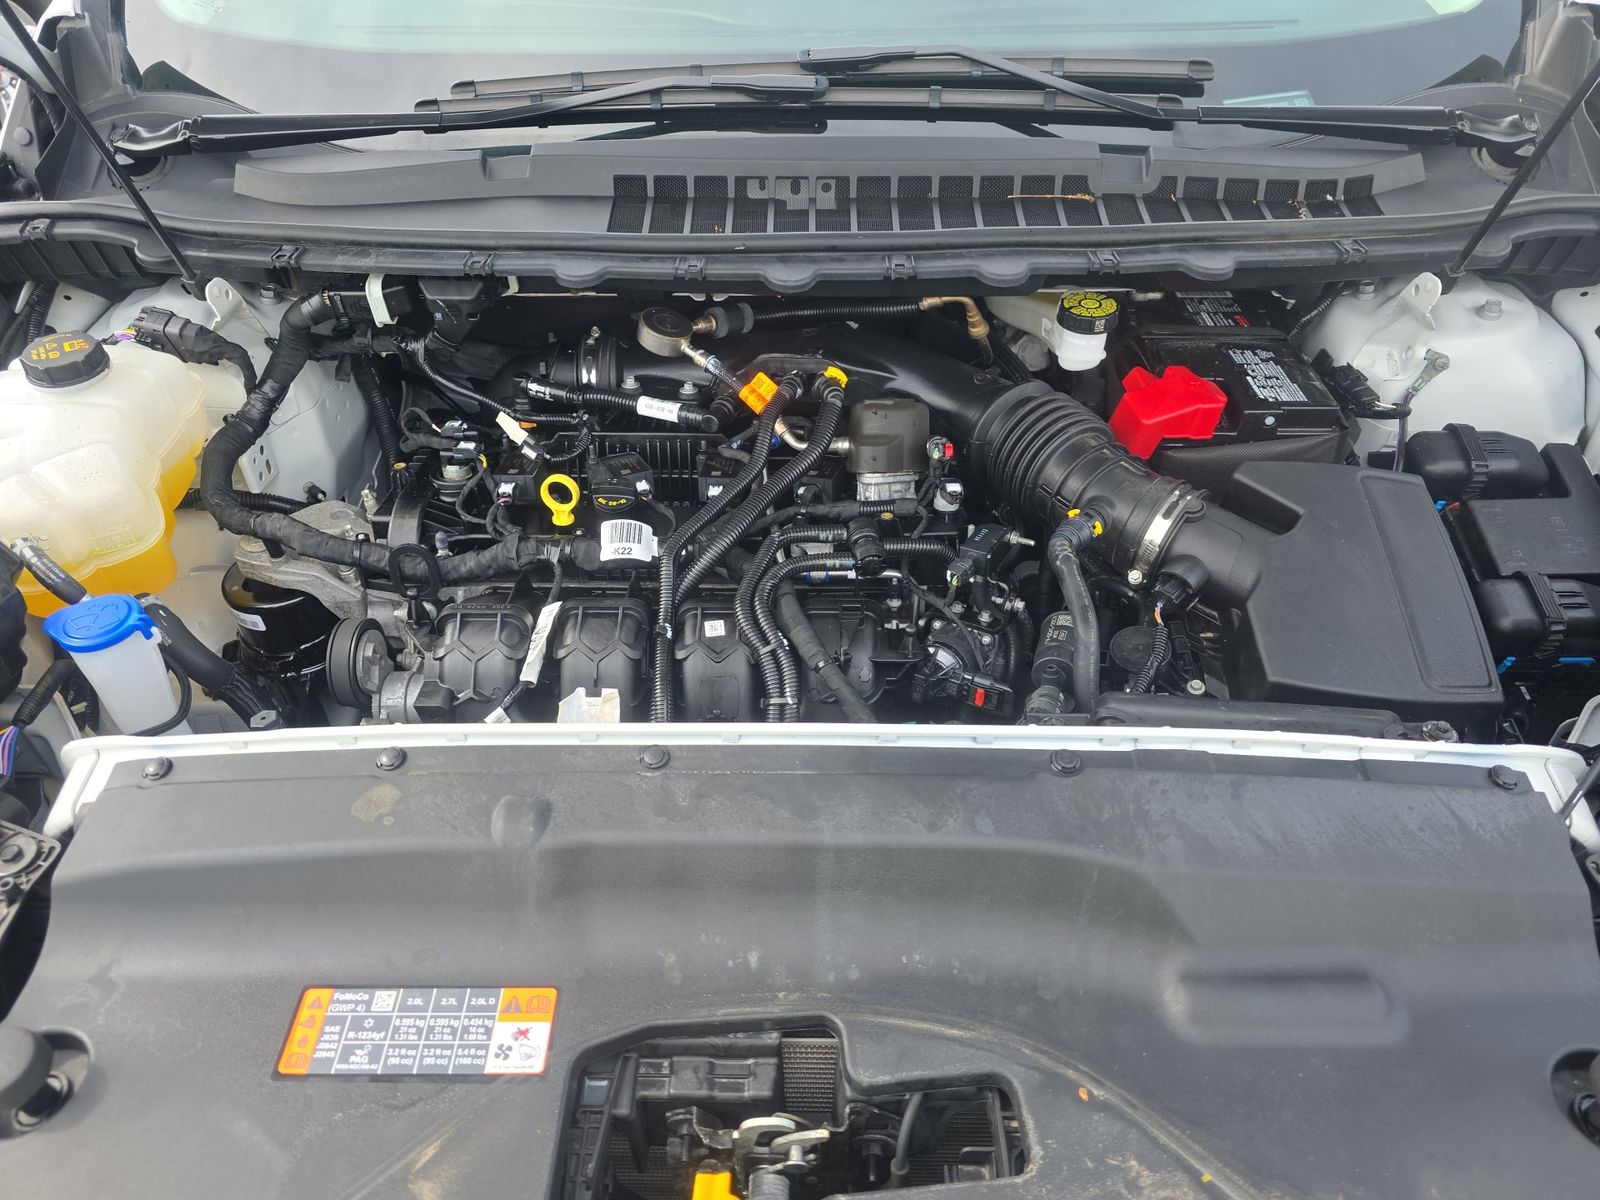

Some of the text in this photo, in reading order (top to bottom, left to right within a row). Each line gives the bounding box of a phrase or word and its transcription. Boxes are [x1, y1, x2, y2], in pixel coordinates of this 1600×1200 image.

[333, 992, 369, 1001] FoMoCo
[406, 997, 424, 1006] 2.0L
[440, 997, 458, 1006] 2.7L
[470, 997, 496, 1006] 2.0L D
[327, 1003, 366, 1013] (GWP 4)
[415, 1018, 425, 1029] kg
[450, 1018, 460, 1029] kg
[463, 1018, 494, 1028] 0.454 kg
[323, 1025, 341, 1033] SAE
[347, 1031, 386, 1041] R-1234yf
[349, 1055, 369, 1064] PAG
